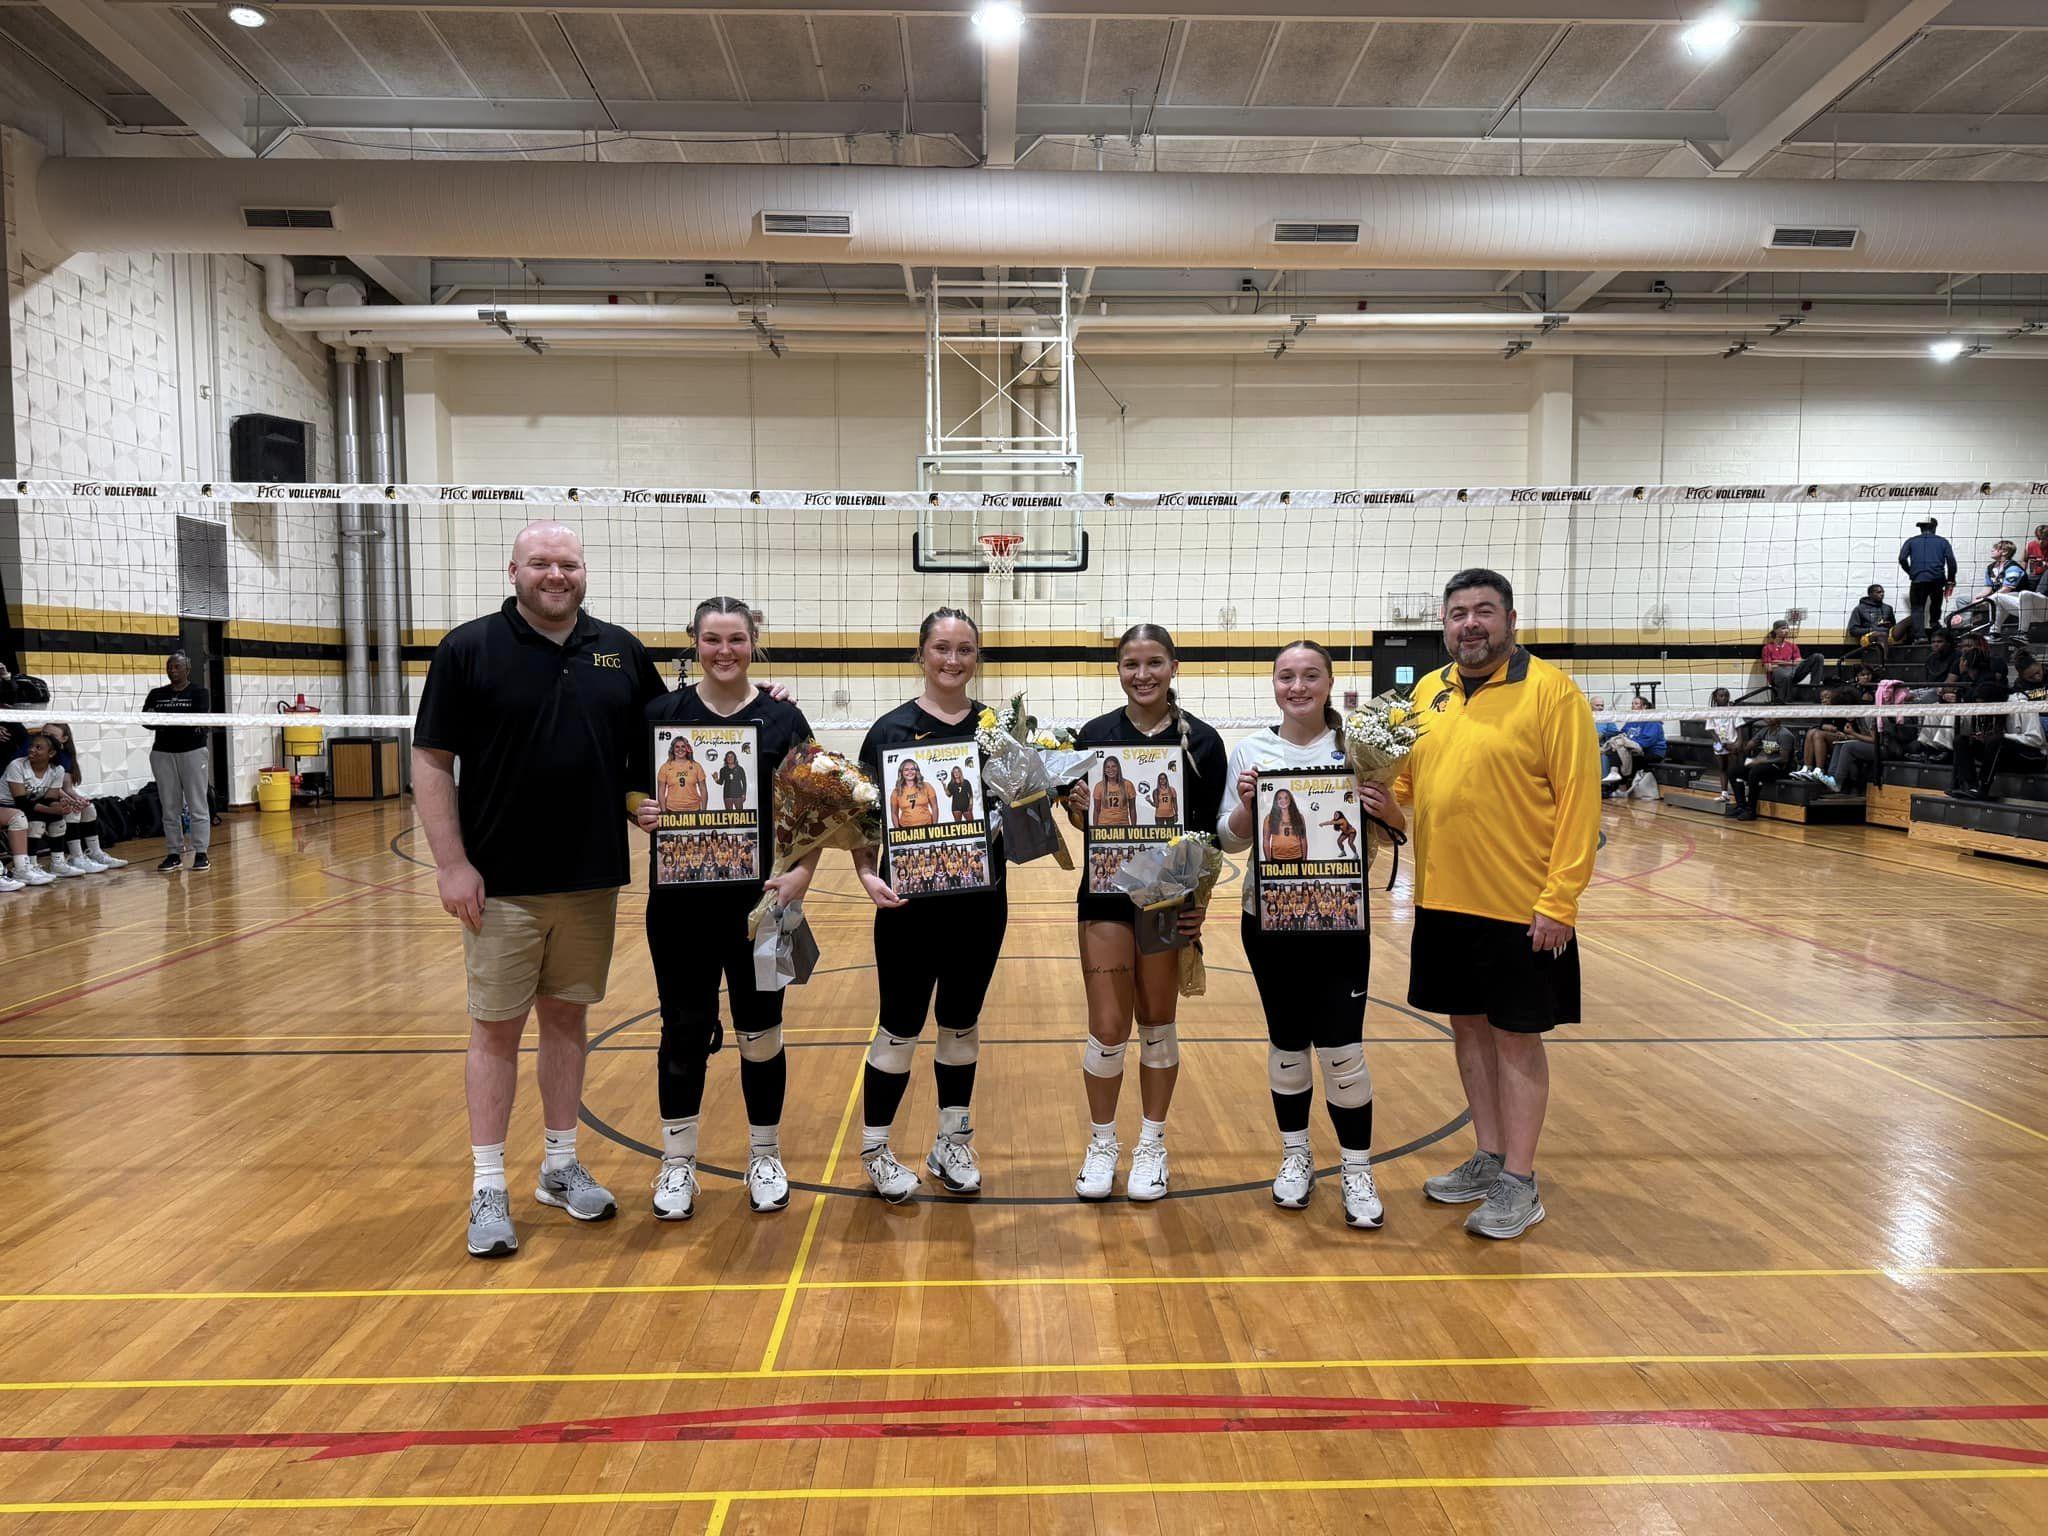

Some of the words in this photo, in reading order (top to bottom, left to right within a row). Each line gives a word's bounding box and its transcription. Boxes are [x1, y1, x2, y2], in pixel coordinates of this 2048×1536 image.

[72, 482, 101, 496] FTCC
[104, 486, 158, 497] VOLLEYBALL
[256, 485, 284, 498] FTCC
[288, 488, 341, 499] VOLLEYBALL
[440, 486, 468, 500] FTCC
[471, 490, 525, 500] VOLLEYBALL
[622, 489, 651, 503] FTCC
[654, 493, 707, 504] VOLLEYBALL
[1510, 487, 1538, 501] FTCC
[1541, 490, 1592, 501] VOLLEYBALL
[1684, 485, 1713, 499] FTCC
[1715, 488, 1766, 499] VOLLEYBALL
[1859, 483, 1886, 497] FTCC
[1888, 486, 1939, 497] VOLLEYBALL
[804, 491, 832, 505] FTCC
[835, 495, 887, 506] VOLLEYBALL
[981, 493, 1009, 507] FTCC
[1012, 496, 1063, 507] VOLLEYBALL
[1156, 492, 1184, 506] FTCC
[1187, 495, 1238, 506] VOLLEYBALL
[1333, 490, 1361, 504] FTCC
[1363, 493, 1415, 504] VOLLEYBALL
[592, 653, 621, 669] FTCC
[658, 731, 672, 741] #9
[887, 754, 899, 764] #7
[915, 745, 969, 760] MADISON
[679, 777, 686, 787] 9
[1261, 782, 1273, 792] #6
[909, 799, 916, 809] 7
[1109, 797, 1119, 807] 12
[658, 814, 697, 828] TROJAN
[699, 812, 757, 826] VOLLEYBALL
[890, 827, 926, 844] TROJAN
[928, 822, 985, 838] VOLLEYBALL
[1091, 828, 1125, 840] TROJAN
[1127, 826, 1180, 840] VOLLEYBALL
[1261, 864, 1298, 877] TROJAN
[1301, 862, 1361, 876] VOLLEYBALL
